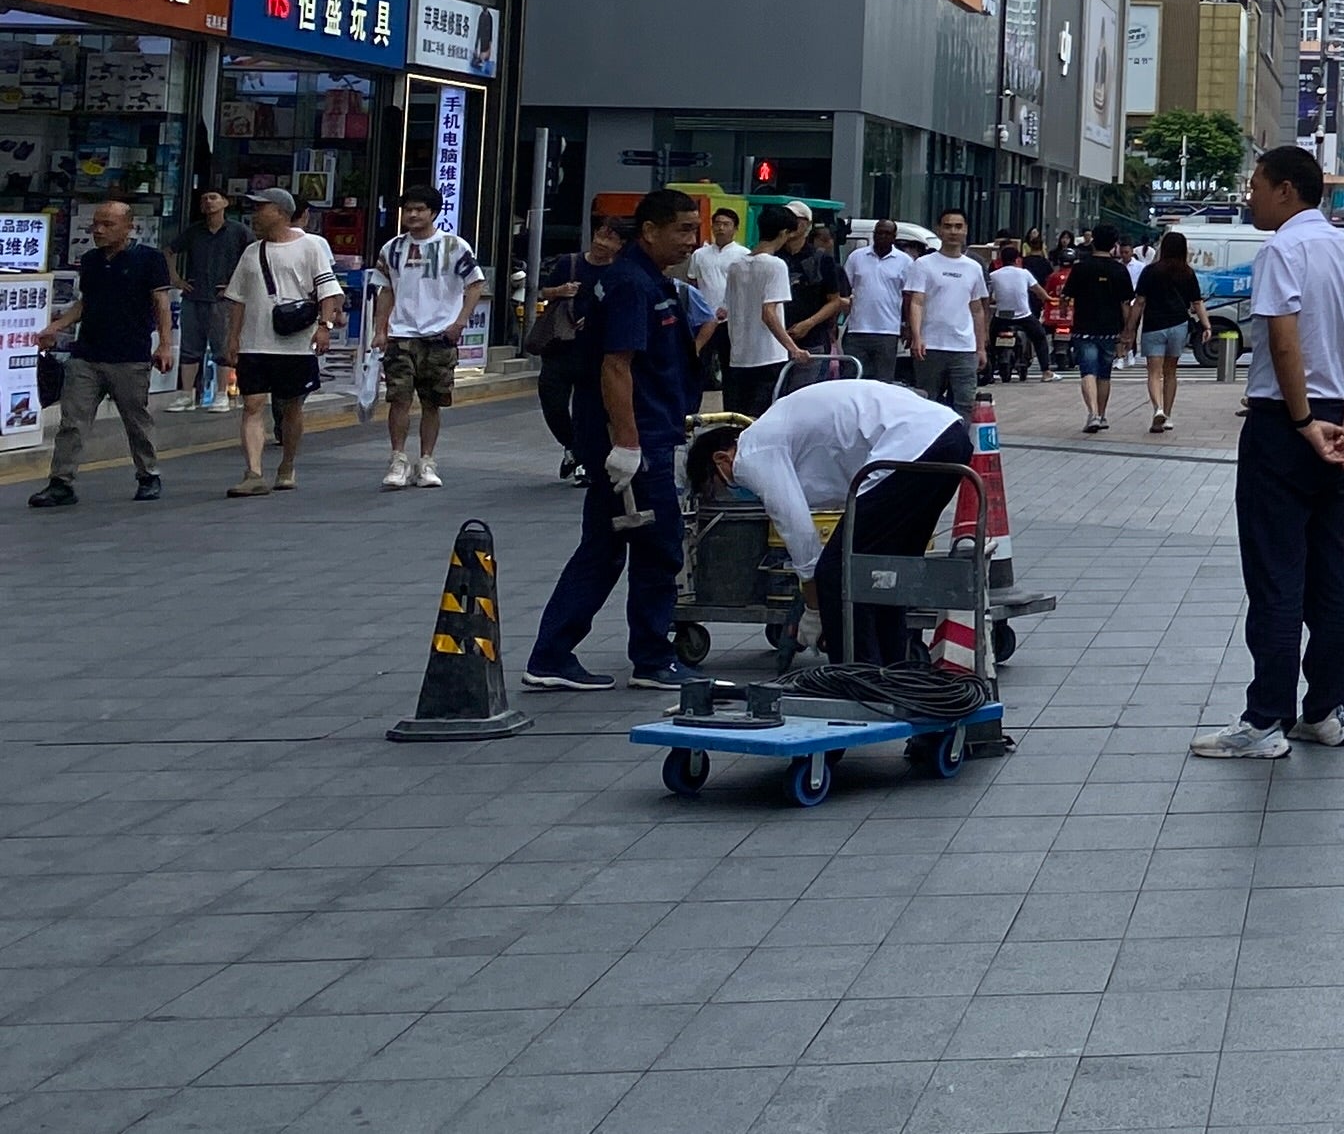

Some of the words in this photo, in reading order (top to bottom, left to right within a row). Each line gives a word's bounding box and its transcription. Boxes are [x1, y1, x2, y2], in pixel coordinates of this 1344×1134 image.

[437, 96, 461, 233] 手机电脑维修中心
